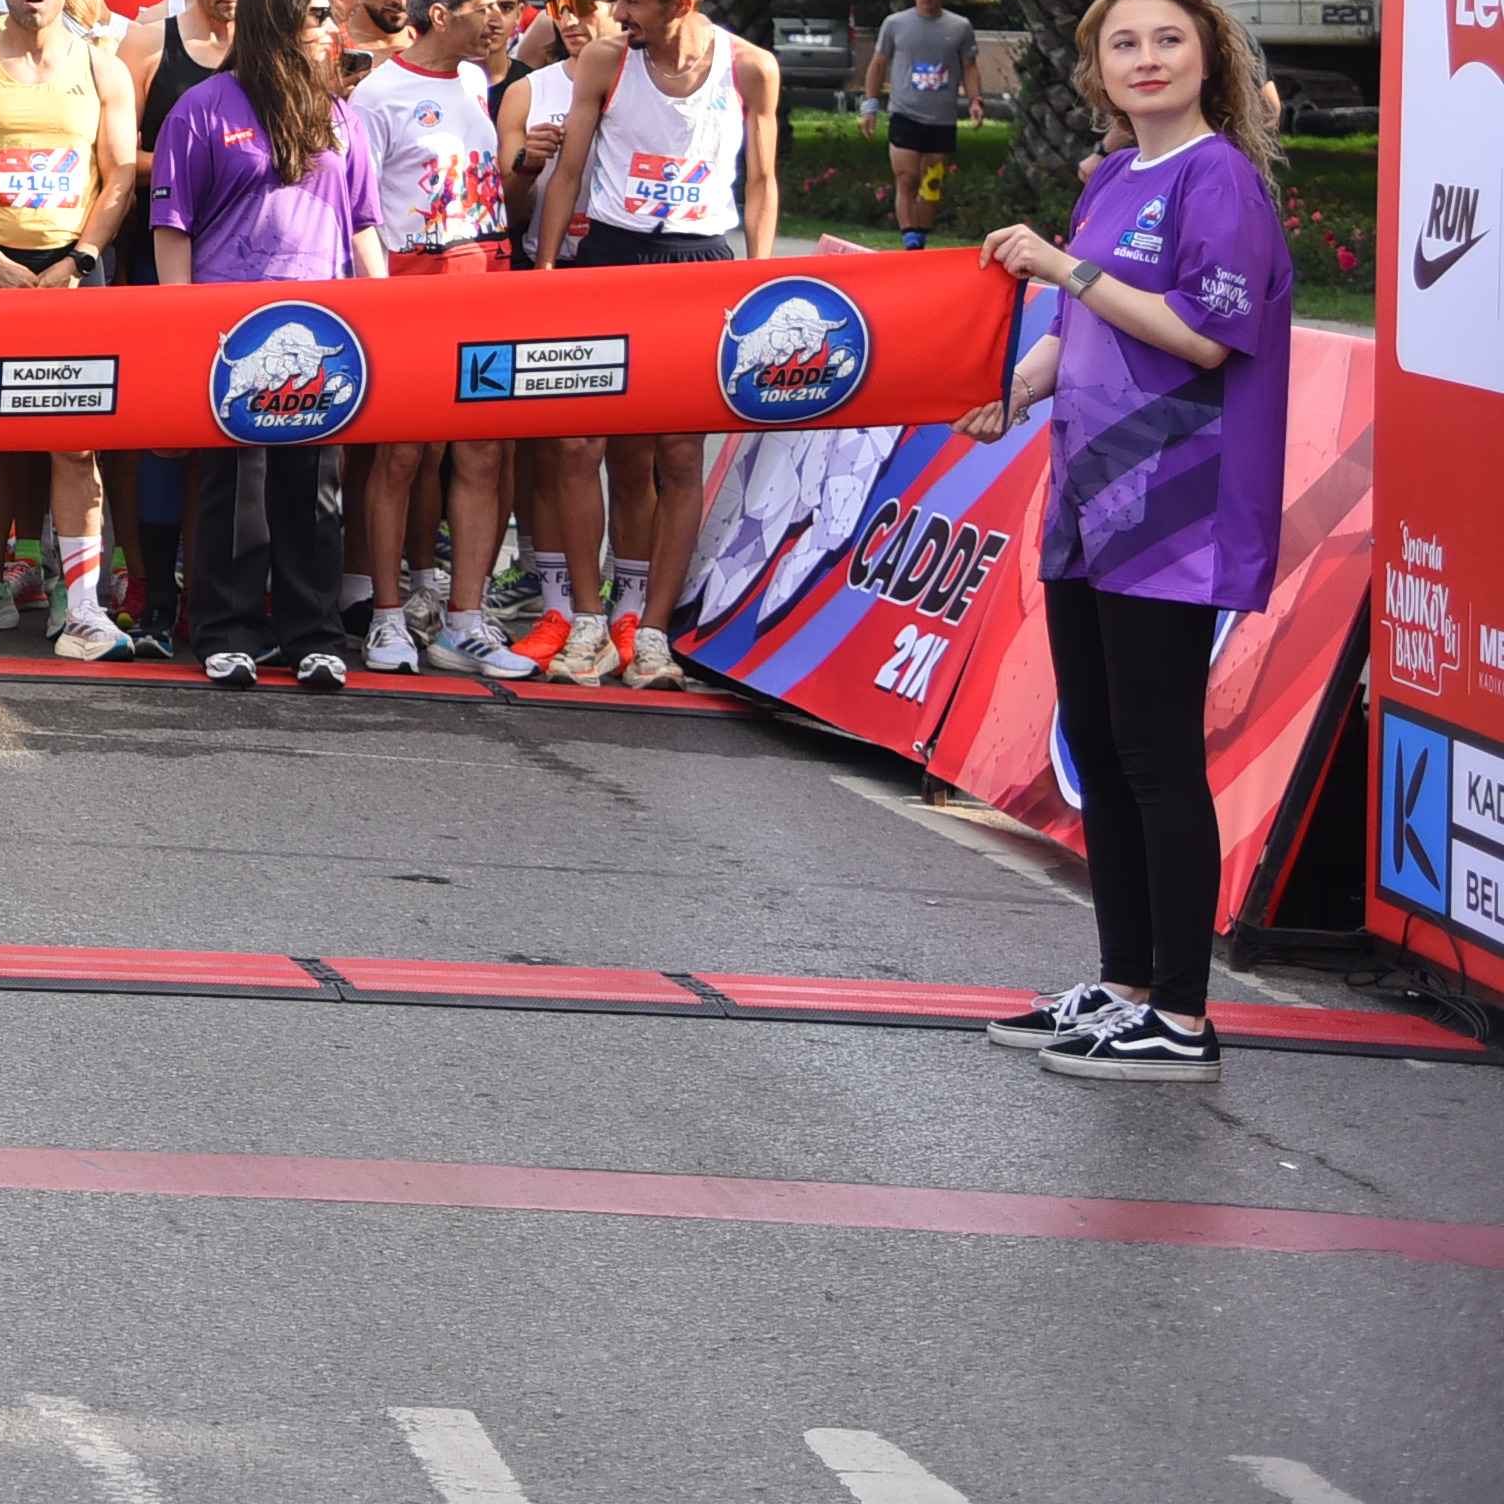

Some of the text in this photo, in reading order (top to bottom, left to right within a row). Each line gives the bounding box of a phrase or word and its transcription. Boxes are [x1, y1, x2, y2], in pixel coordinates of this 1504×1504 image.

[1322, 4, 1373, 26] 220
[8, 175, 70, 192] 4148
[636, 180, 701, 203] 4208
[1425, 182, 1480, 244] RUN
[1113, 247, 1159, 265] GÖNÜLLÜ
[526, 343, 595, 365] KADIKÖY
[12, 362, 83, 384] KADIKÖY
[524, 371, 614, 394] BELEDİYESİ
[754, 365, 840, 391] CADDE
[9, 389, 103, 410] BELEDİYESİ
[248, 390, 333, 415] CADDE
[759, 384, 830, 404] 10K-21K
[252, 410, 328, 430] 10K-21K
[1400, 519, 1443, 573] Sporda
[847, 497, 1010, 627] CADDE
[1386, 561, 1450, 637] KADIKÖY
[873, 622, 950, 704] 21K
[1395, 622, 1437, 682] BAŞKA
